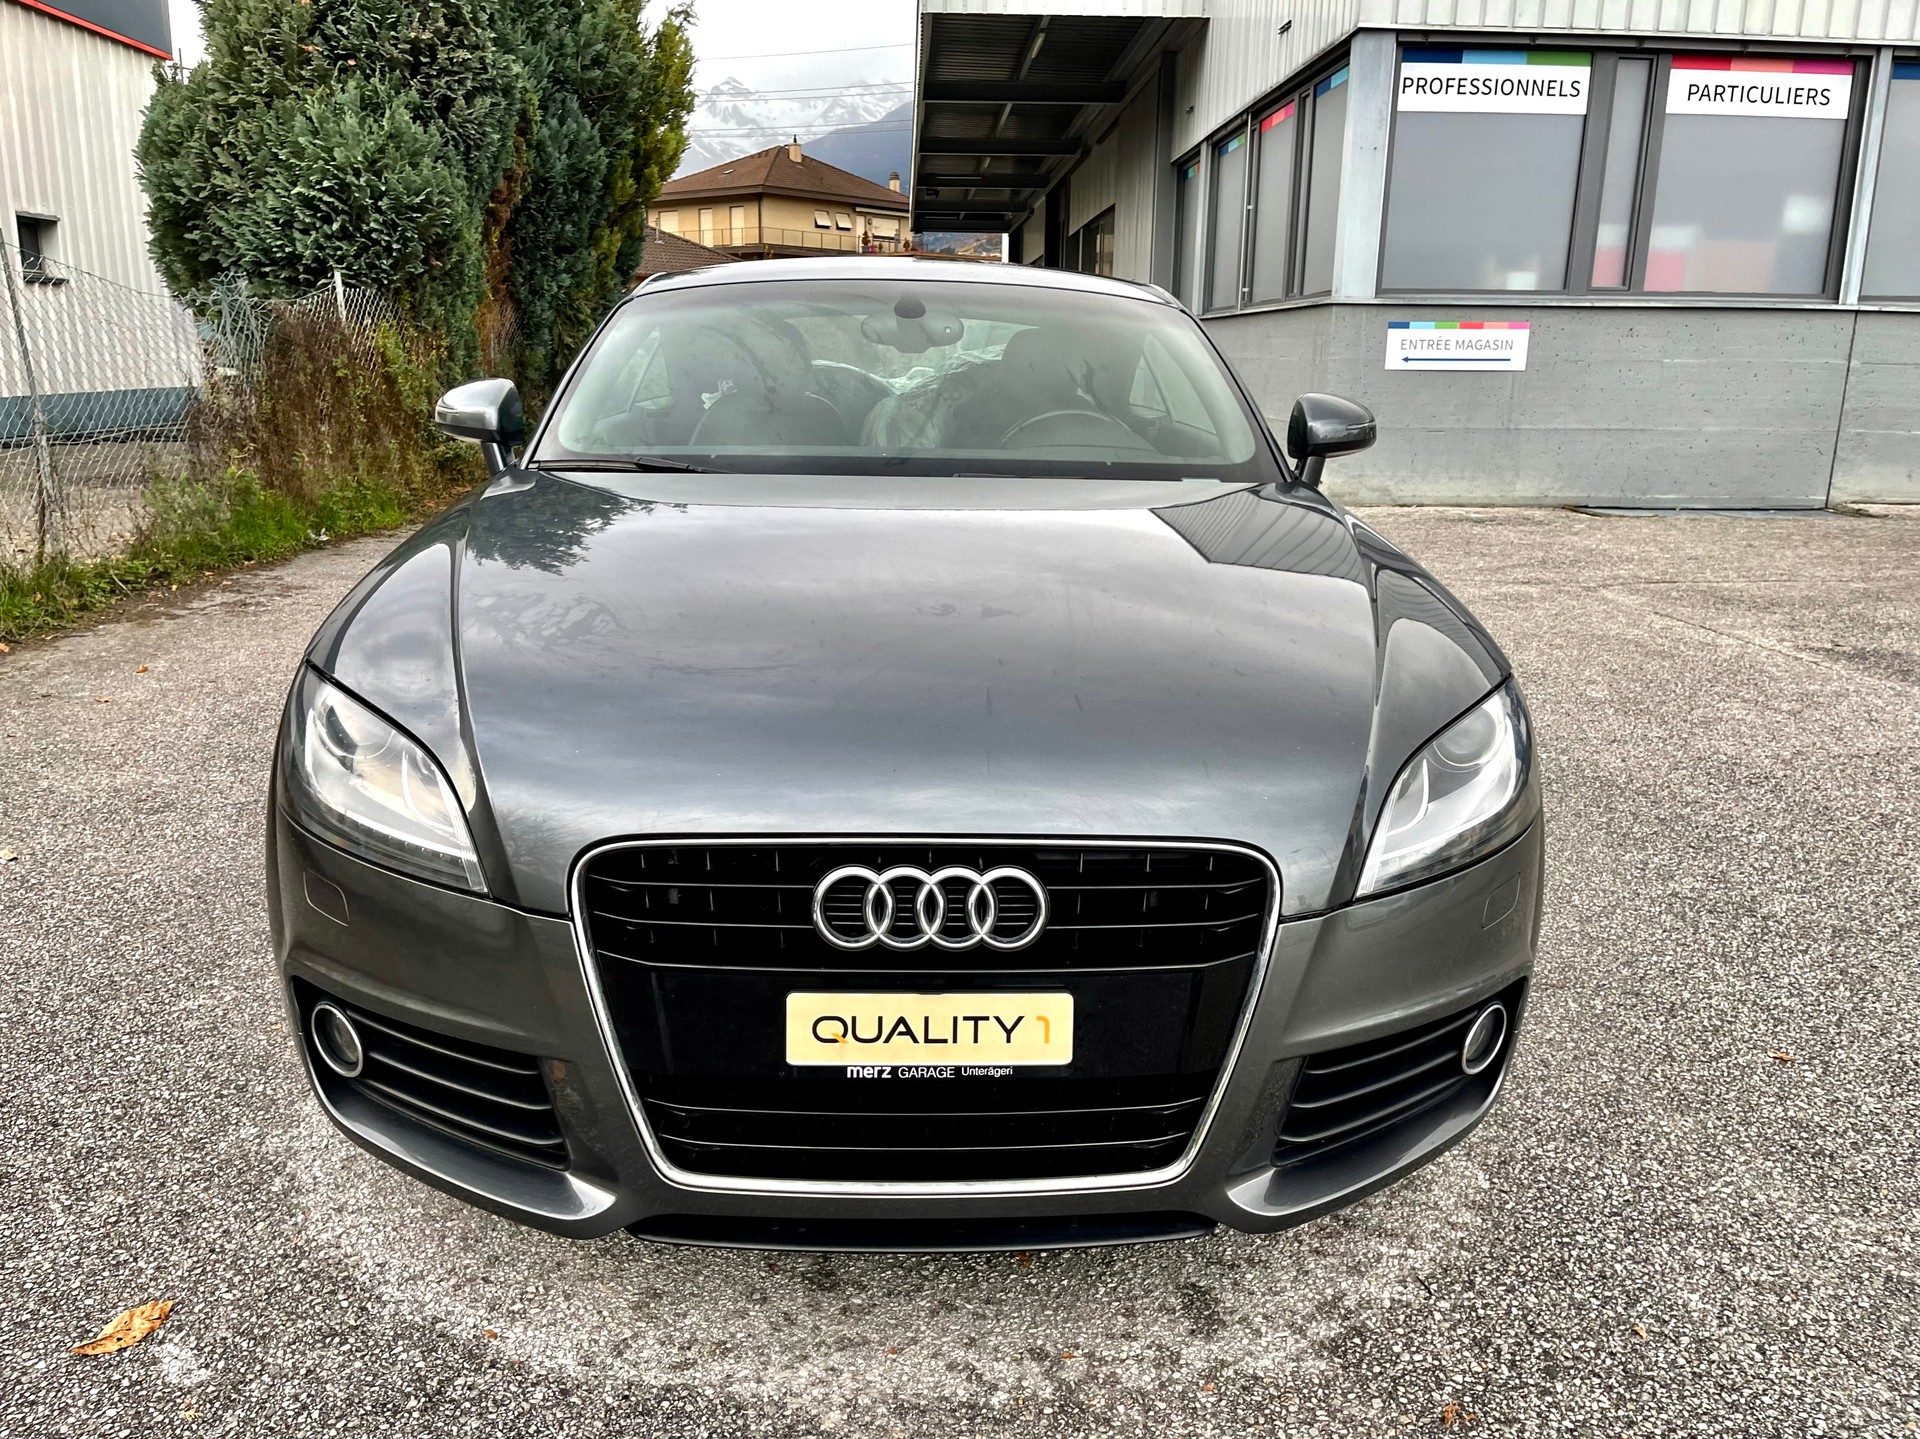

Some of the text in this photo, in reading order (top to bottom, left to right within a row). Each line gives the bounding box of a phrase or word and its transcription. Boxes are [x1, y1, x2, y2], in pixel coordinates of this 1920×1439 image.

[1402, 76, 1581, 98] PROFESSIONNELS
[1687, 83, 1831, 106] PARTICULIERS
[1400, 336, 1514, 351] ENTRÉE MAGASIN
[812, 1015, 1050, 1044] QUALITY 1
[847, 1065, 1013, 1078] merz GARAGE Unterägeri
